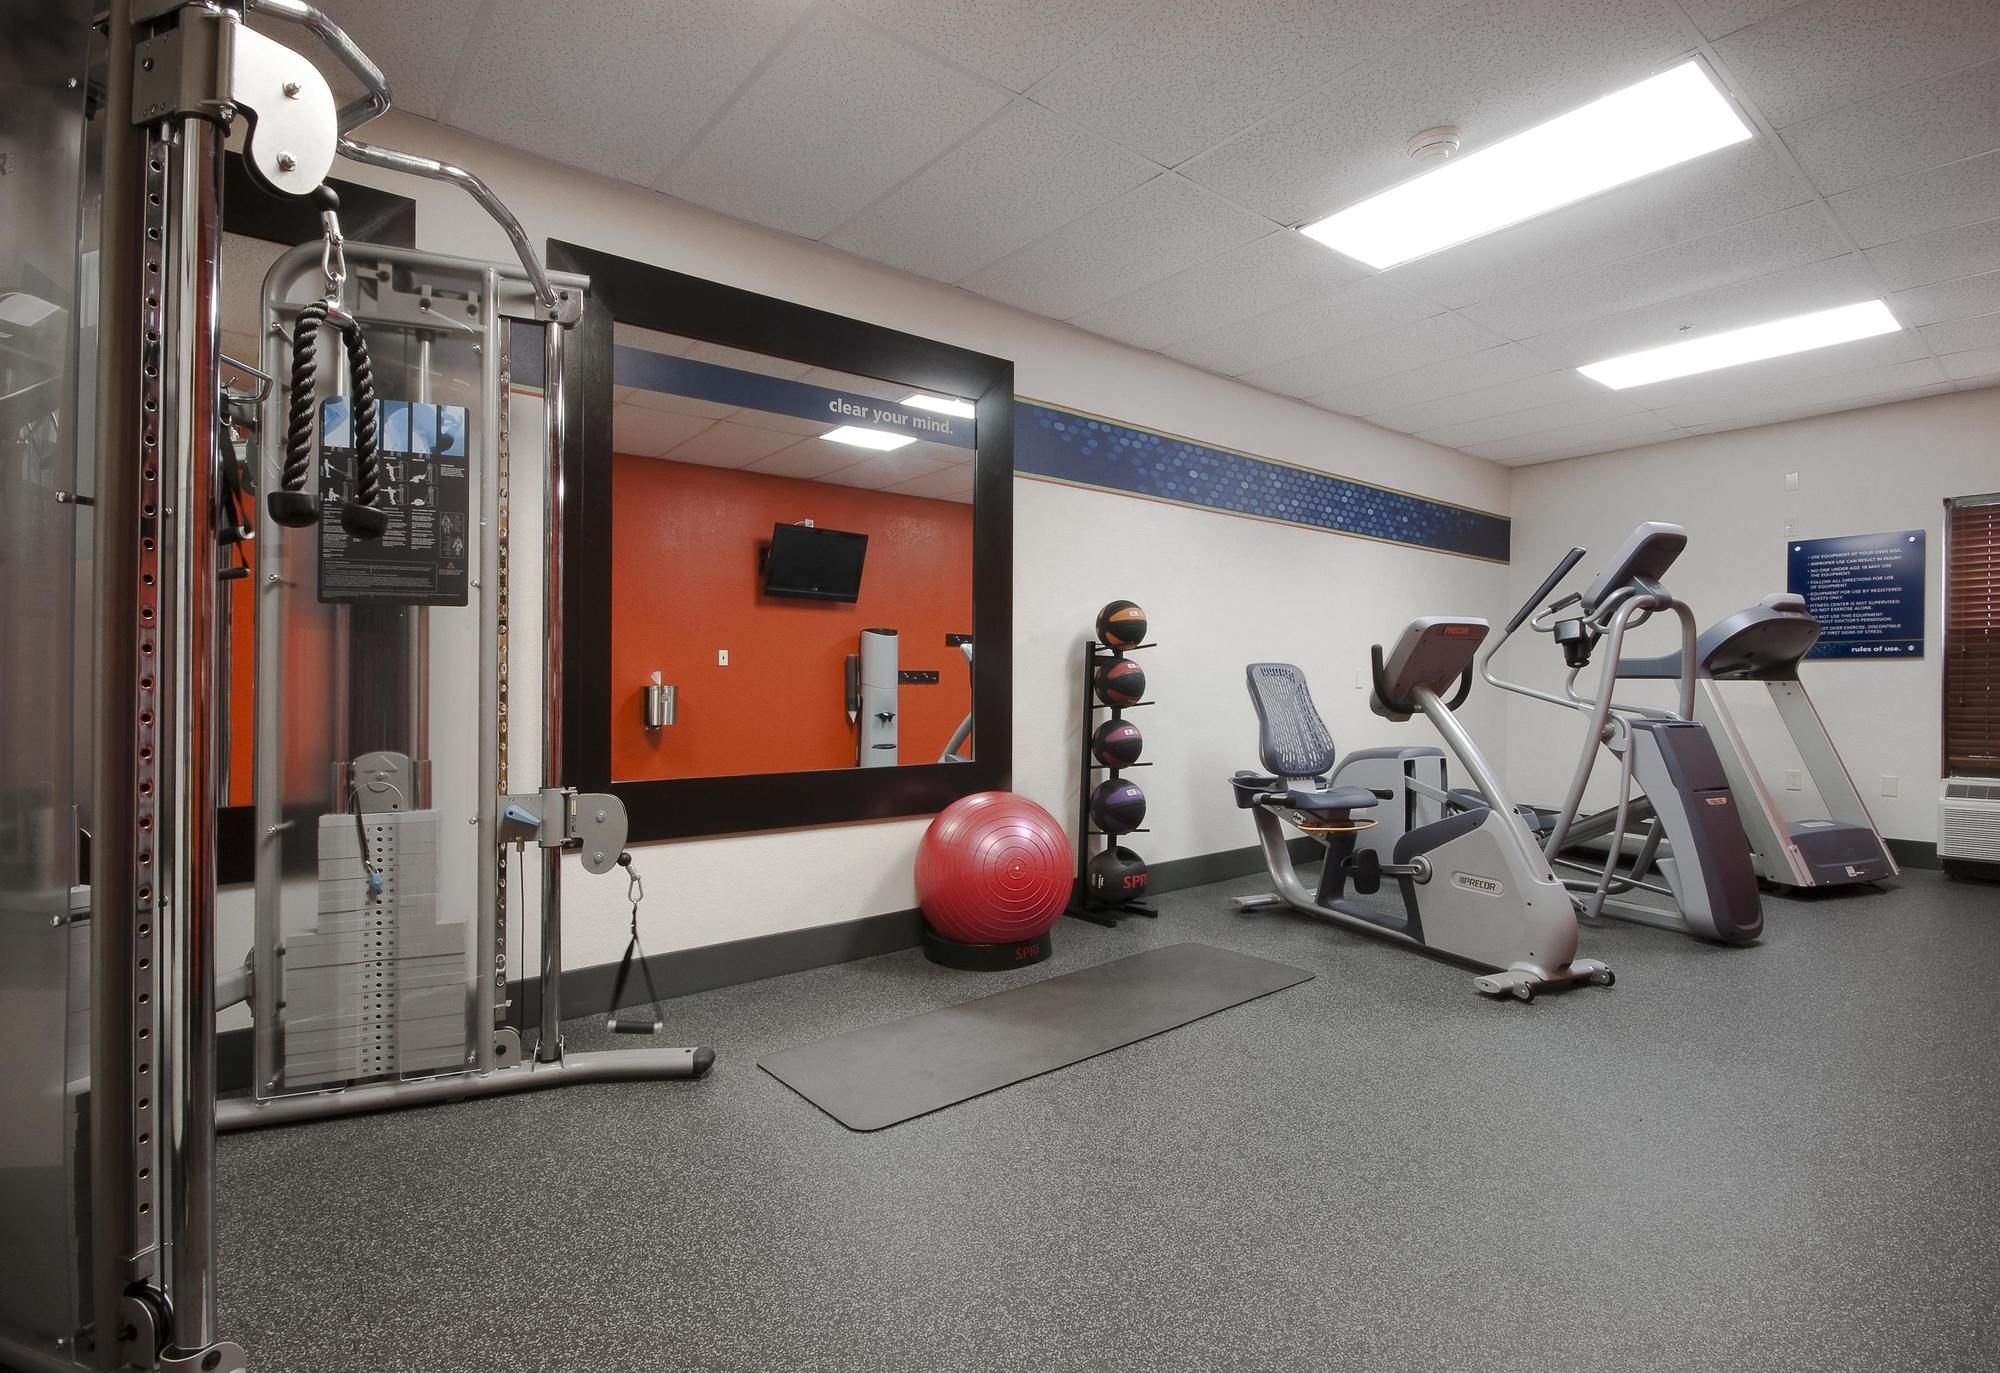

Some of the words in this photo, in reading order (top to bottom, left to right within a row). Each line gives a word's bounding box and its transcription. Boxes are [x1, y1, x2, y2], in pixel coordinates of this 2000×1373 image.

[828, 398, 869, 418] clear
[872, 408, 909, 425] your
[912, 416, 954, 435] mind.
[1463, 877, 1496, 891] PRECOR
